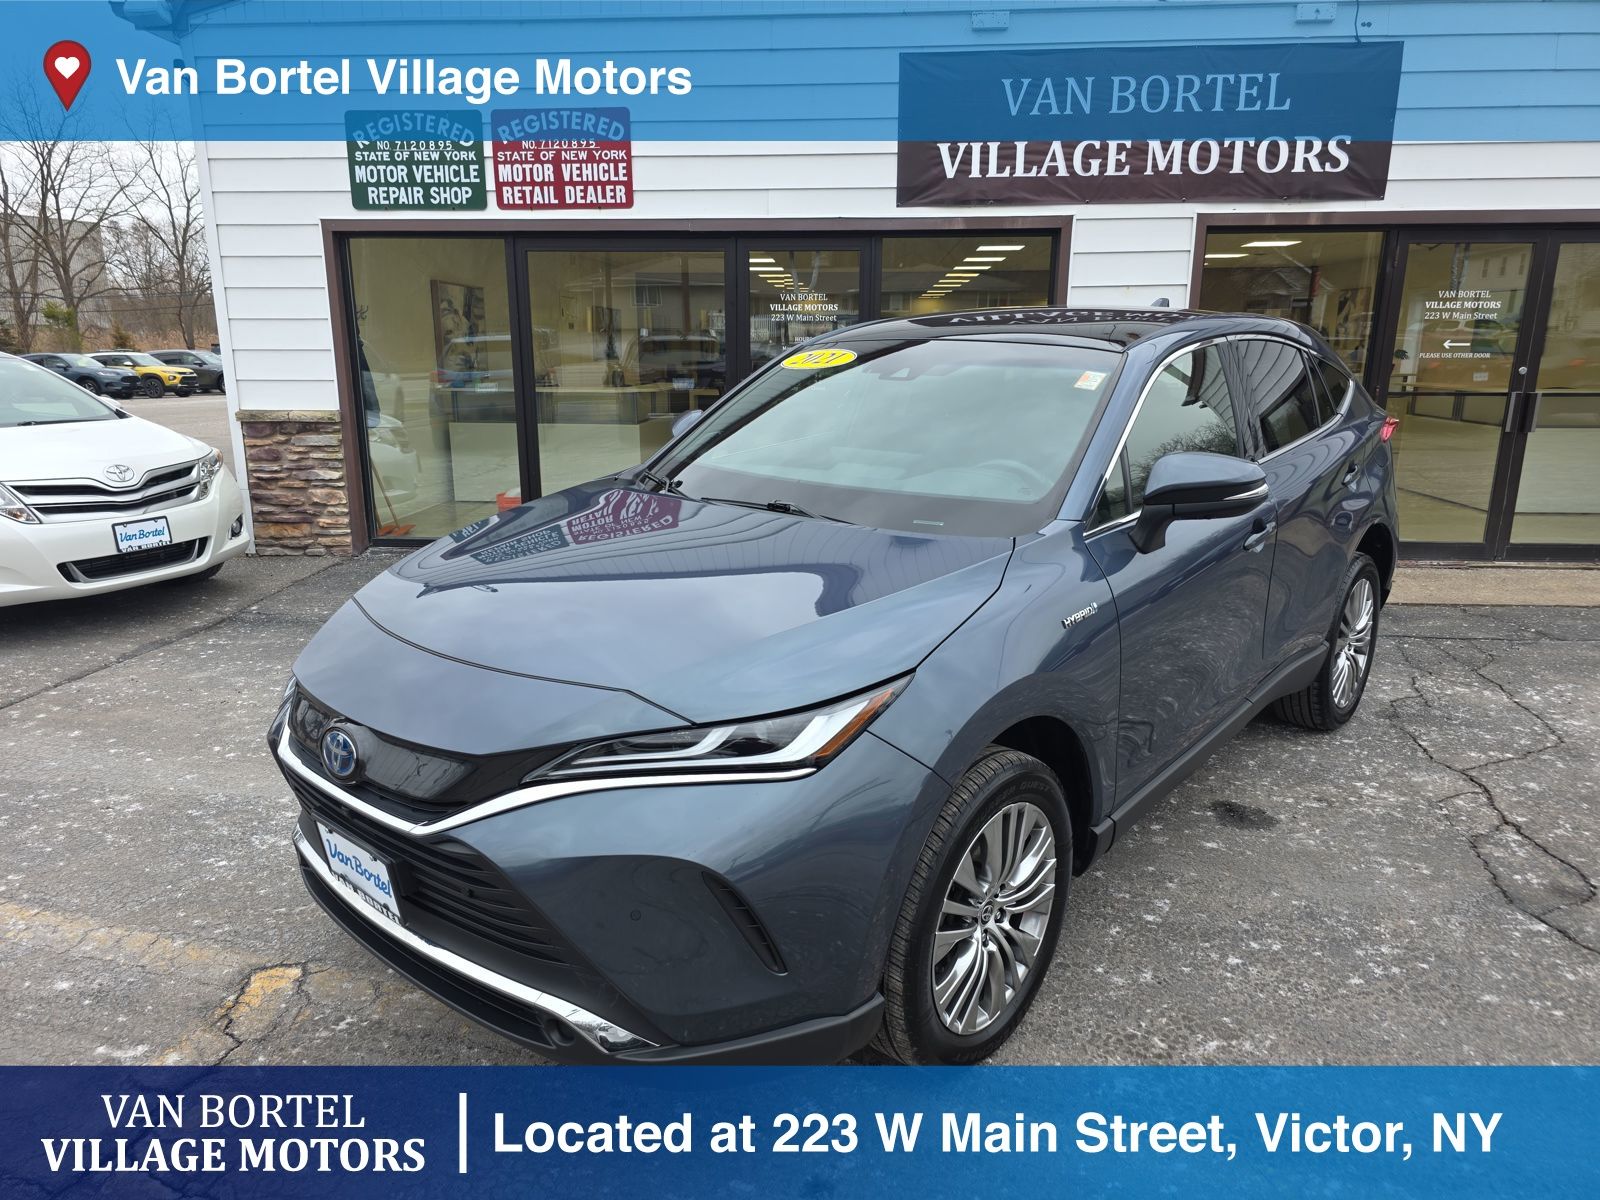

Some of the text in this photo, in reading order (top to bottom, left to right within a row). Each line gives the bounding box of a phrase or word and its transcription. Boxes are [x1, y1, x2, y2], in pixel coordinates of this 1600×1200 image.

[1002, 72, 1291, 117] VAN BORTEL
[353, 112, 475, 149] REGISTERED
[497, 110, 625, 145] REGISTERED
[395, 140, 453, 151] 7120895
[521, 138, 597, 150] NO. 7120895
[355, 150, 477, 162] STATE OF NEW YORK
[497, 149, 628, 162] STATE OF NEW YORK
[937, 134, 1353, 180] VILLAGE MOTORS
[354, 164, 481, 183] MOTOR VEHICLE
[497, 162, 628, 183] MOTOR VEHICLE
[367, 186, 473, 205] REPAIR SHOP
[502, 185, 627, 205] RETAIL DEALER
[779, 293, 829, 301] VAN BORTEL
[1438, 290, 1491, 298] VAN BORTEL
[769, 303, 839, 311] VILLAGE MOTORS
[1425, 301, 1502, 309] VILLAGE MOTORS
[771, 314, 837, 322] 223 W Main Street
[1424, 312, 1440, 320] 223
[120, 525, 165, 543] Van Bortel
[1061, 605, 1094, 630] HYBRID
[326, 838, 355, 871] Van
[351, 854, 393, 899] Bortel
